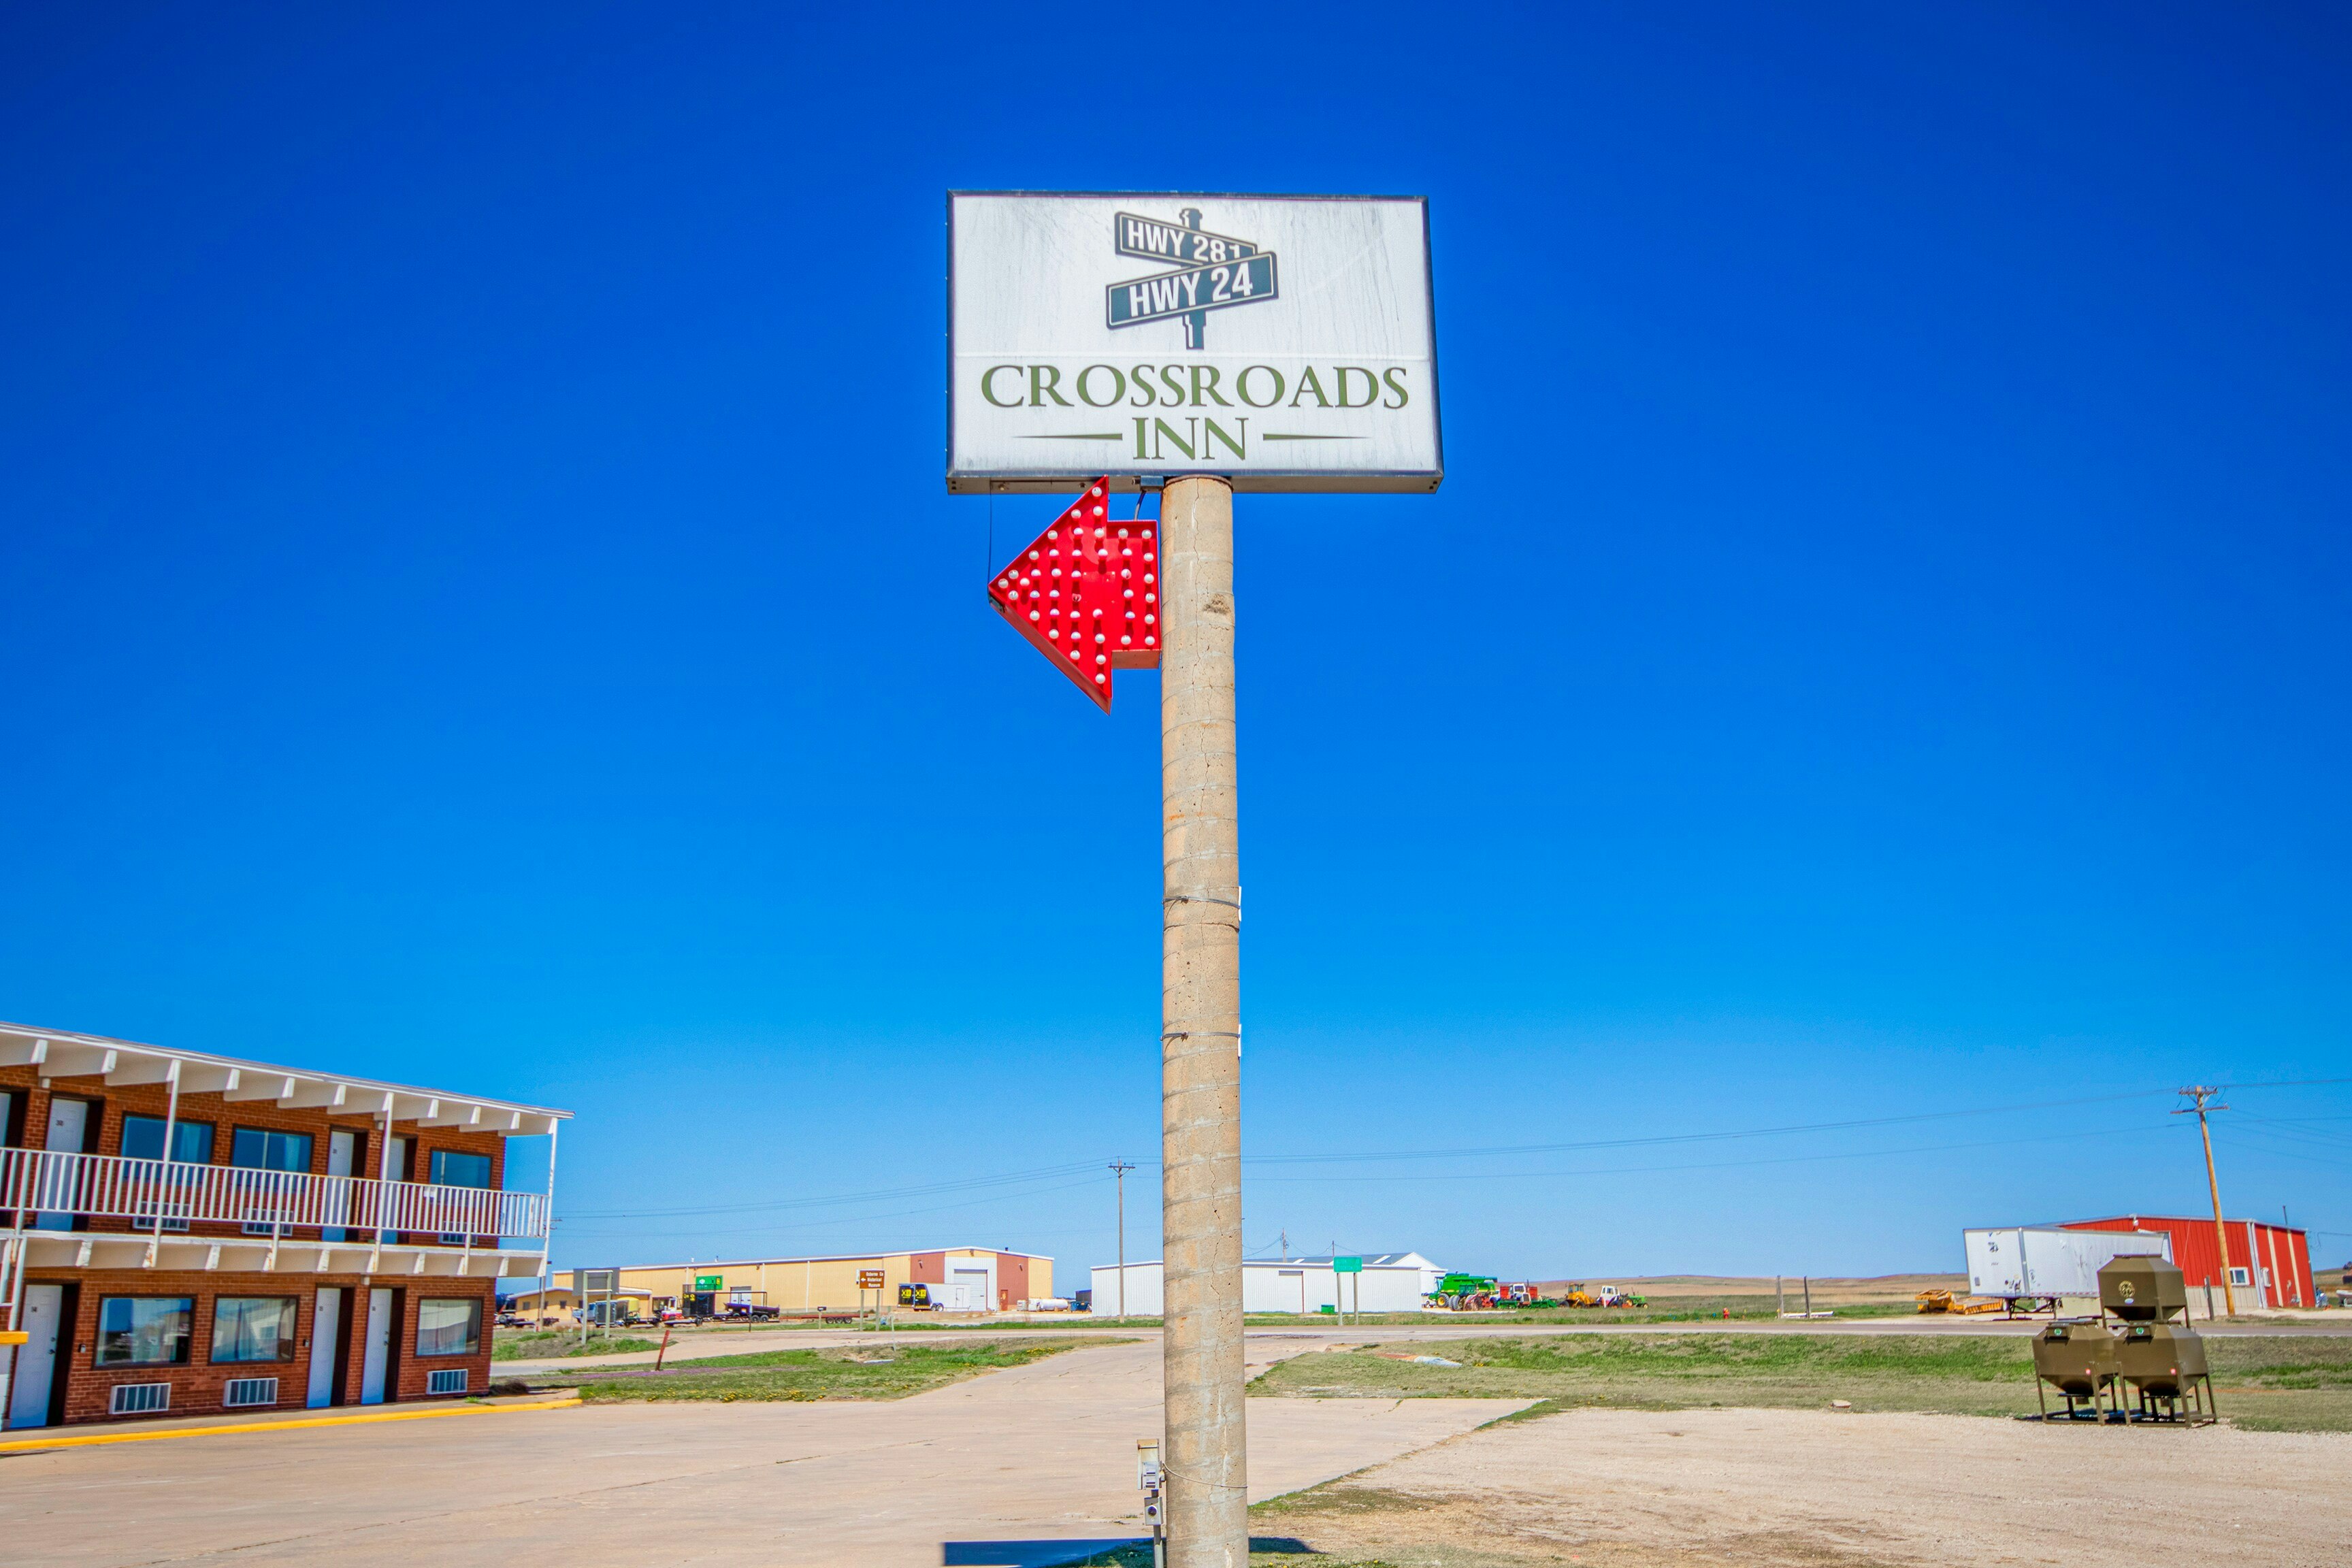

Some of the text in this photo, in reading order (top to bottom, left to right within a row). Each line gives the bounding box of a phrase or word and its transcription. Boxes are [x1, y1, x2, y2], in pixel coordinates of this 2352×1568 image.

[1128, 220, 1241, 263] HWY 281
[1130, 261, 1253, 317] HWY 24
[981, 365, 1409, 410] CROSSROADS
[1132, 417, 1249, 461] INN
